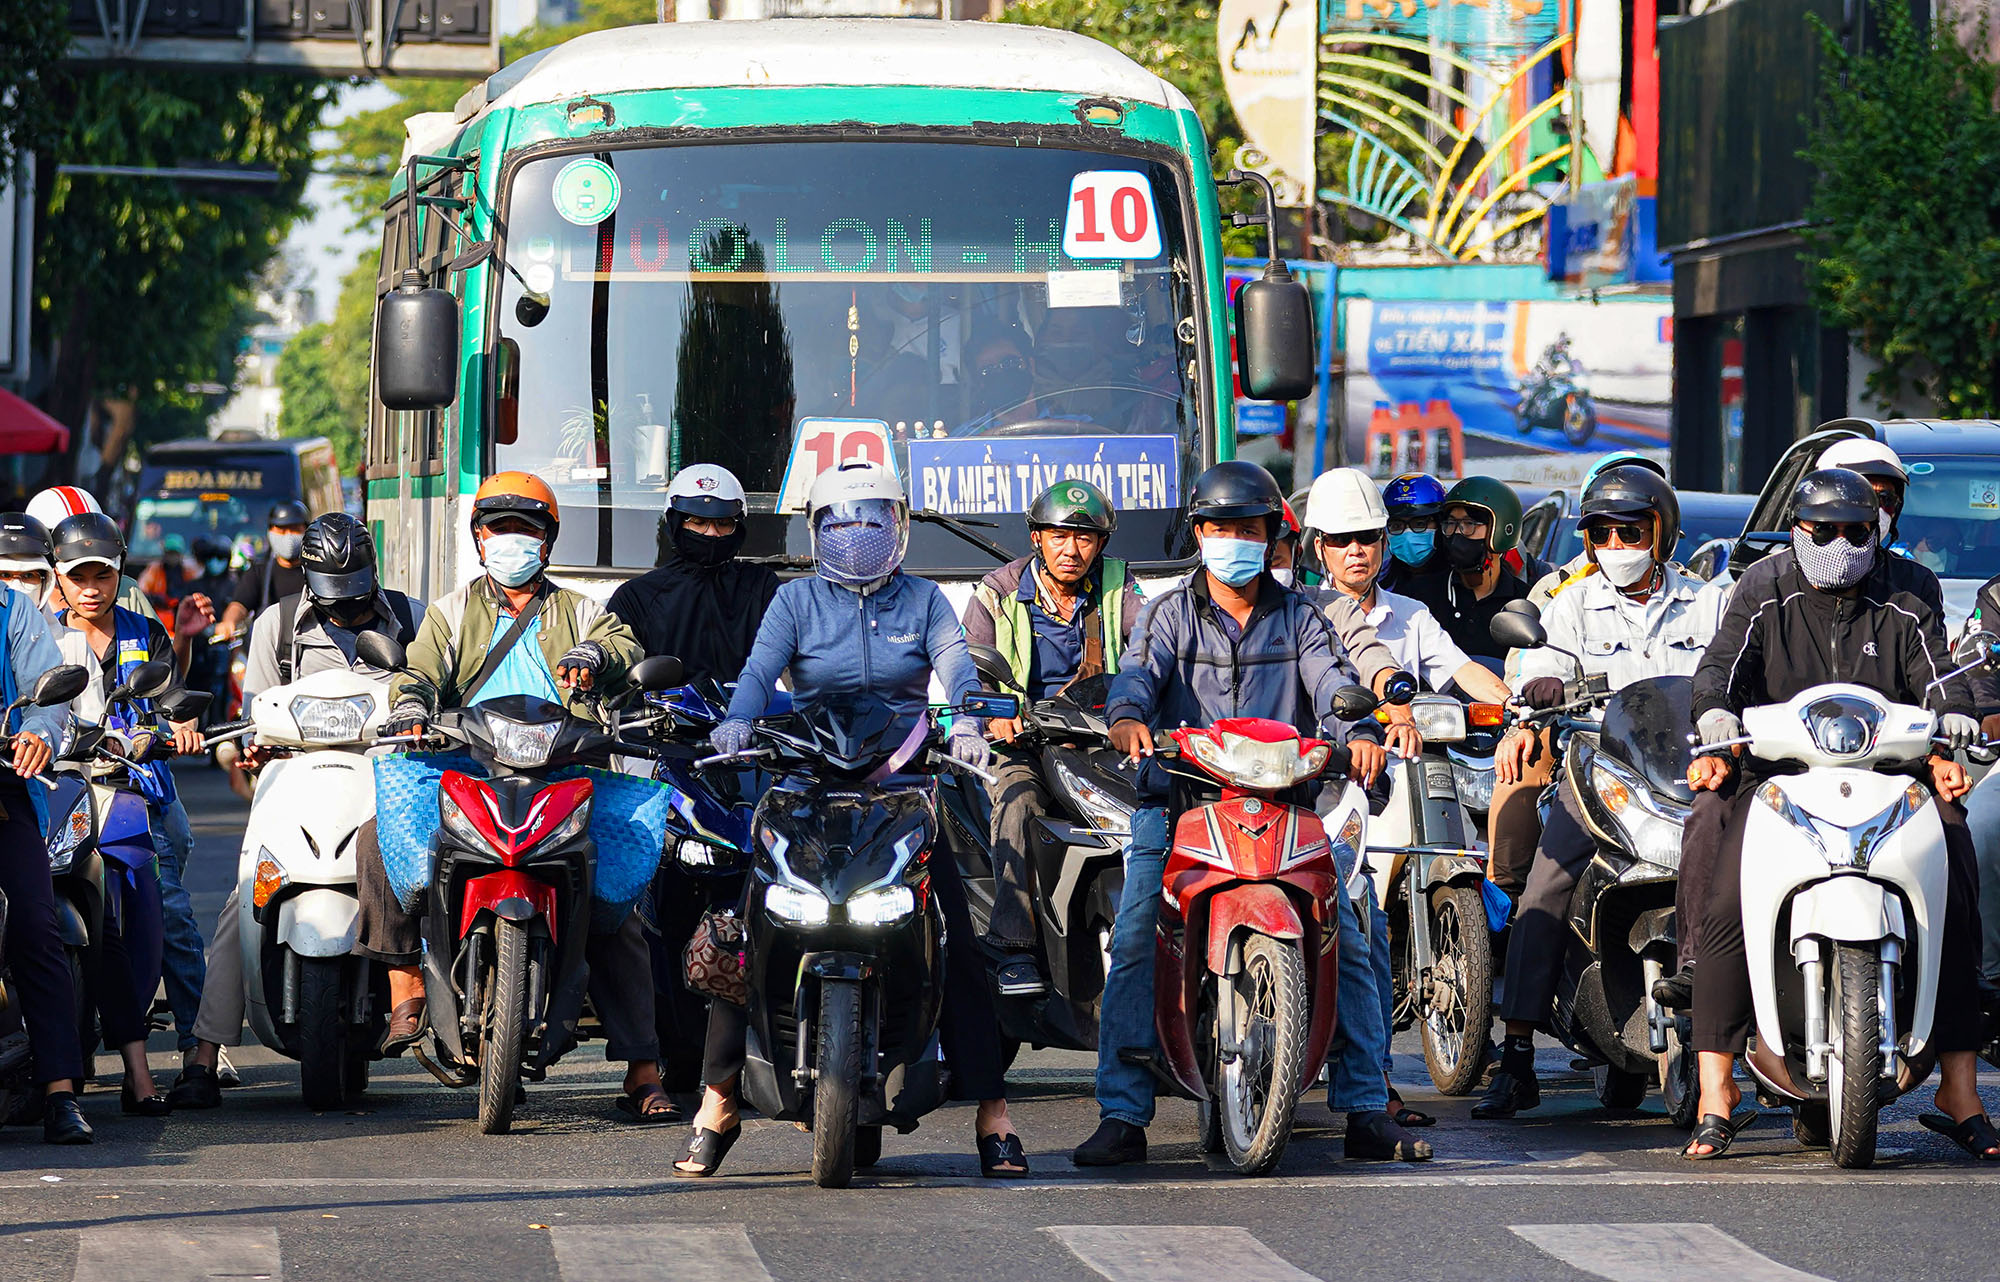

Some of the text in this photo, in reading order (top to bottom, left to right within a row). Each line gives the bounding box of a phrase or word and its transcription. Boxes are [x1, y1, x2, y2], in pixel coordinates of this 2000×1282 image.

[1074, 186, 1148, 243] 10
[775, 217, 932, 273] LON
[1117, 451, 1167, 511] TIÊN
